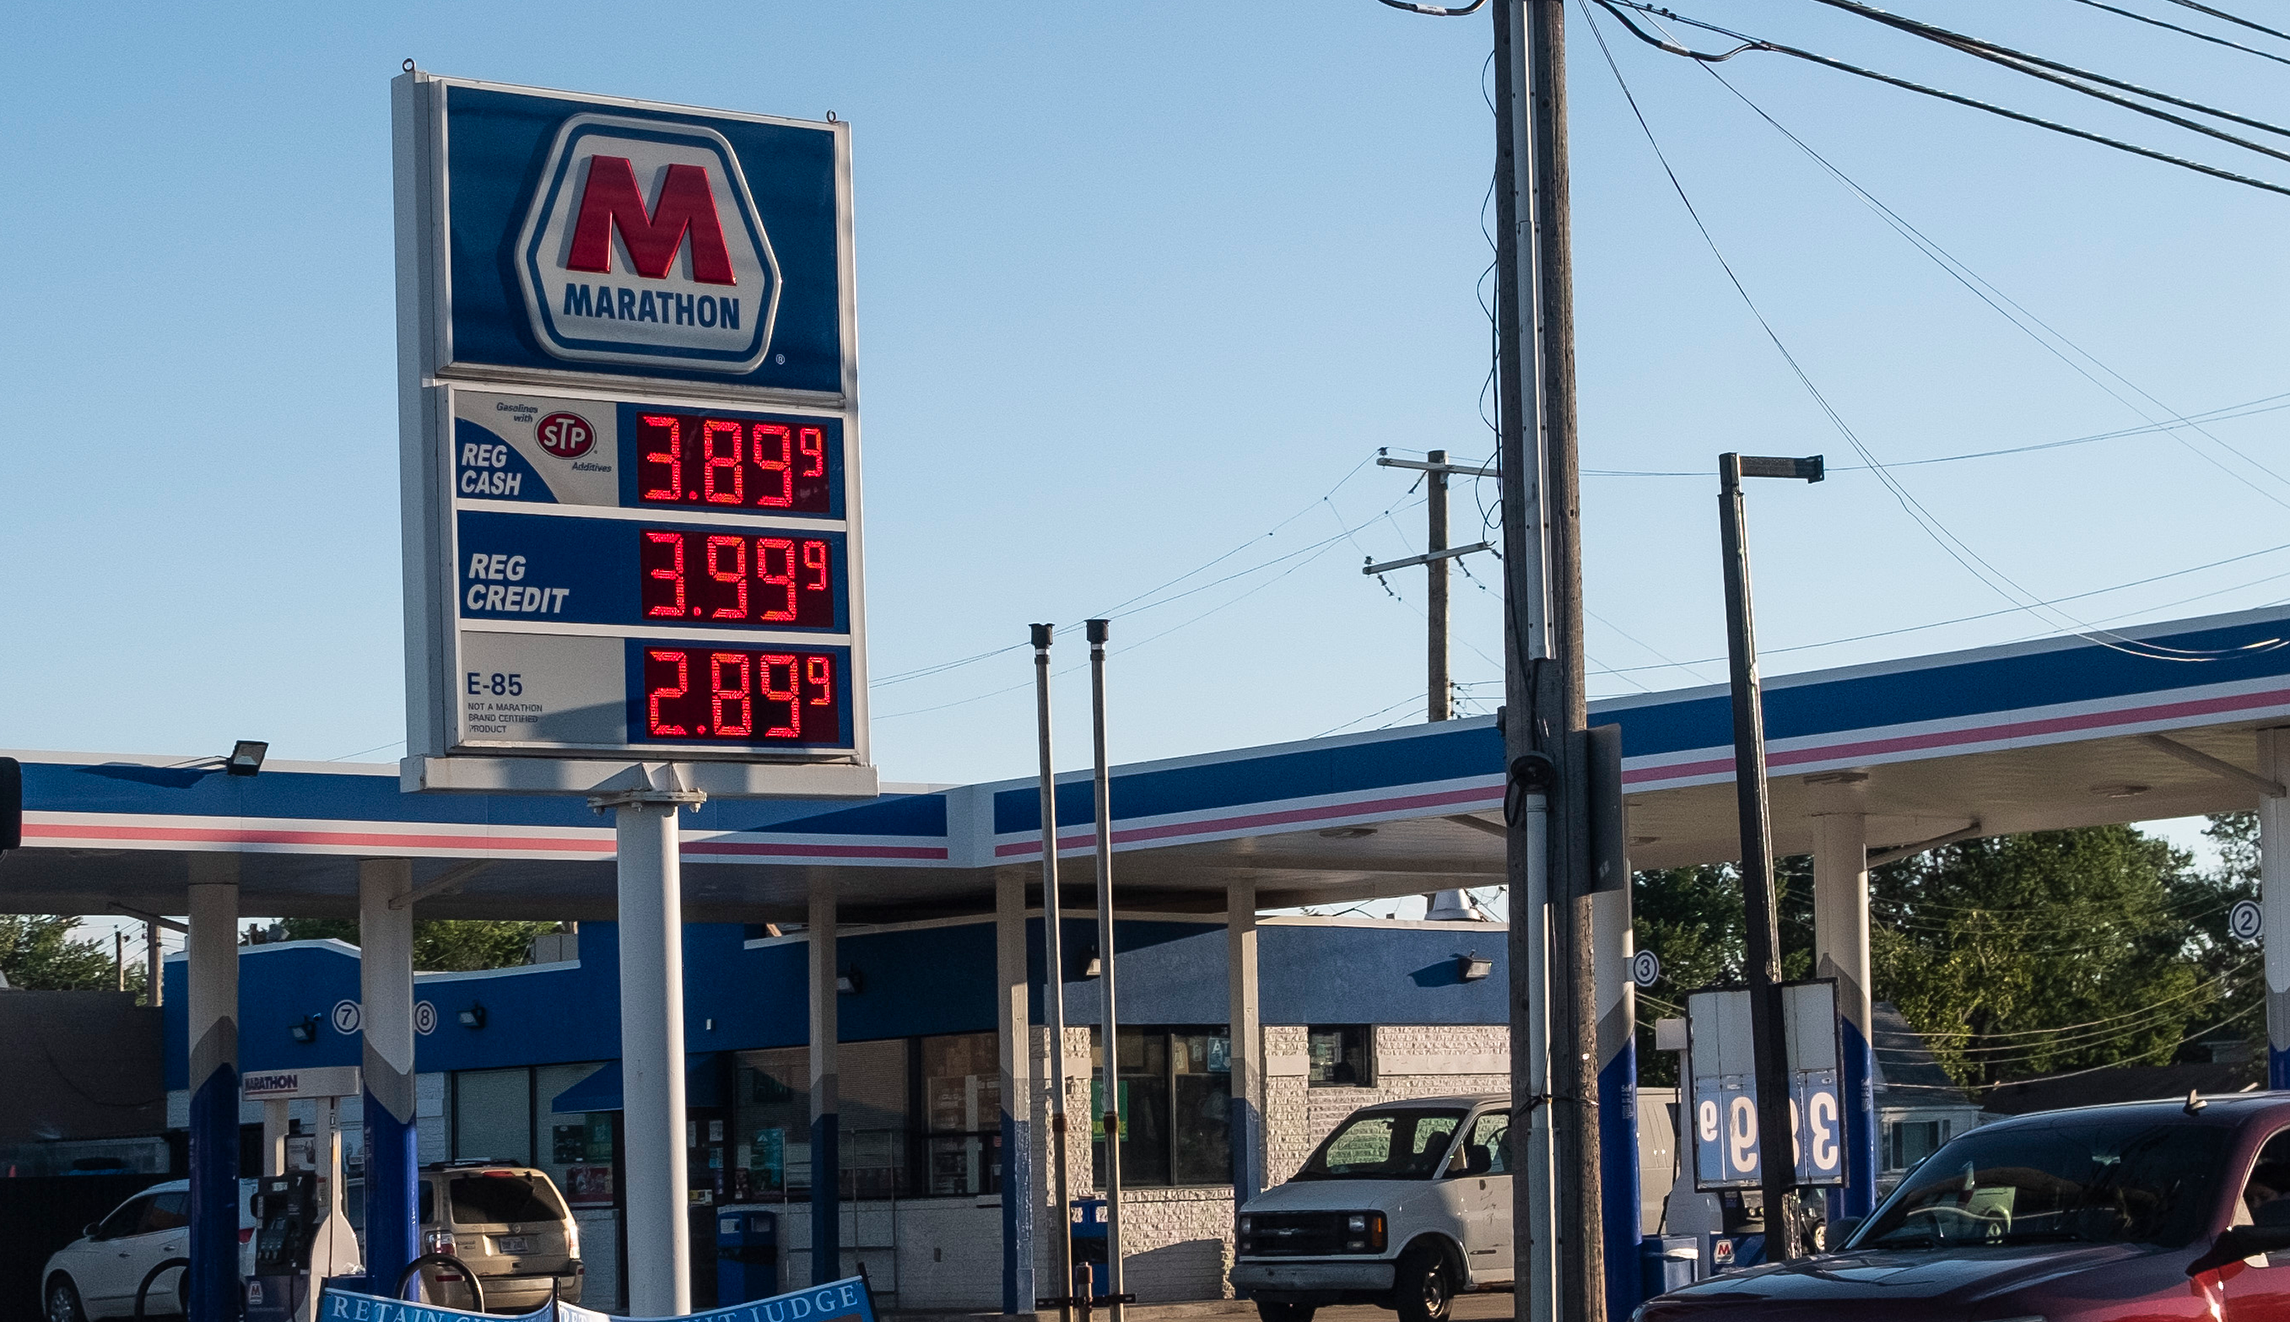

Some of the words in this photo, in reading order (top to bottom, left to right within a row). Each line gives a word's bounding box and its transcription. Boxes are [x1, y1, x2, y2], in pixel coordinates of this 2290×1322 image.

[566, 154, 737, 286] M
[563, 283, 740, 331] MARATHON
[496, 402, 539, 414] Gasolines
[513, 414, 533, 423] with
[543, 417, 586, 450] STP
[461, 443, 507, 468] REG
[571, 462, 612, 473] Additives
[461, 470, 522, 496] CASH
[468, 553, 527, 582] REG
[466, 584, 570, 614] CREDIT
[467, 672, 523, 697] E-85
[467, 702, 485, 711] NOT
[487, 703, 494, 711] A
[495, 703, 543, 712] MARATHON
[468, 713, 496, 722] BRAND
[498, 714, 539, 723] CERTIFIED
[469, 725, 507, 733] PRODUCT
[2240, 910, 2253, 931] 2
[1640, 959, 1650, 977] 3
[341, 1008, 353, 1026] 7
[420, 1009, 430, 1026] 8
[244, 1074, 298, 1091] MARATHON
[1718, 1243, 1731, 1256] M
[750, 1284, 858, 1322] JUDGE
